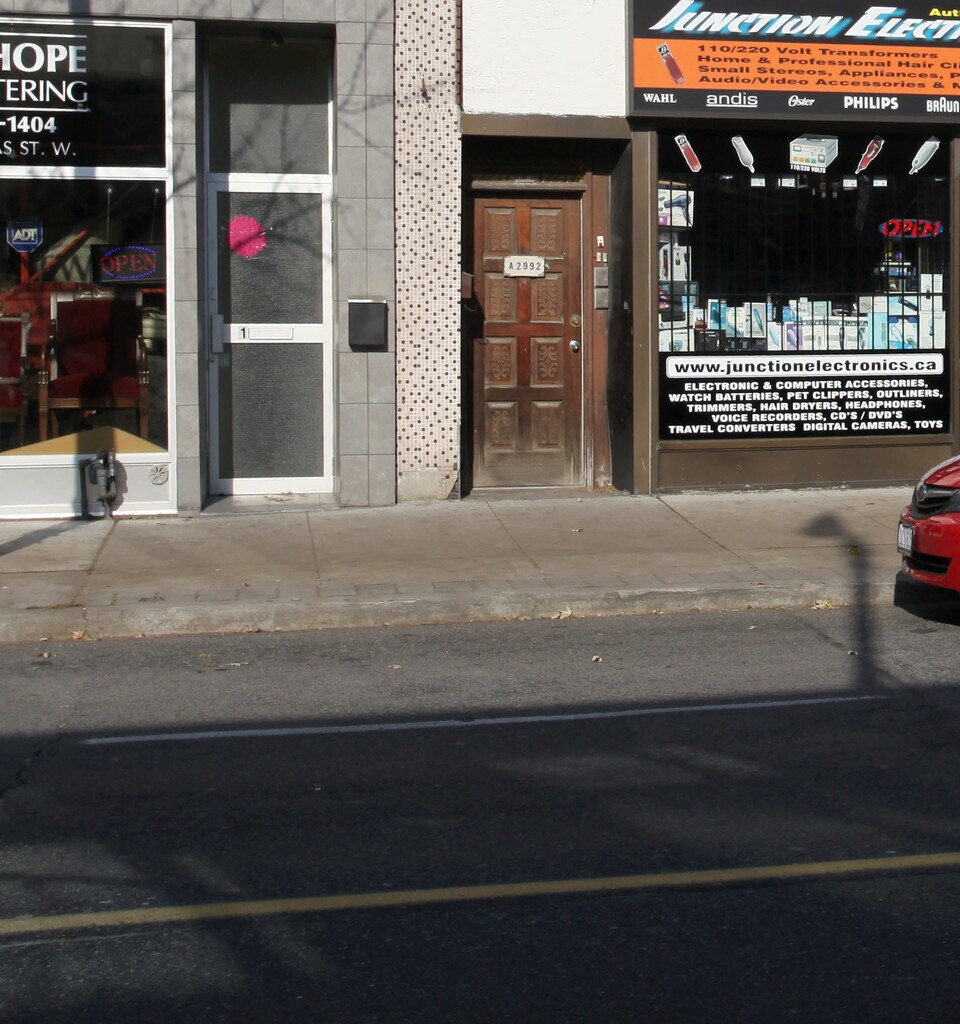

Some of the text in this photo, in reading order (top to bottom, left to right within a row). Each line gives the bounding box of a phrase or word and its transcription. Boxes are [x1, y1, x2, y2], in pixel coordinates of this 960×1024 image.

[648, 0, 844, 35] JUNCTION
[698, 45, 938, 59] 110/220 Volt Transformers
[698, 55, 750, 64] Home
[778, 57, 891, 67] Professional
[898, 61, 934, 69] Hair
[698, 65, 749, 74] Small
[756, 67, 833, 77] Stereos,
[839, 69, 944, 80] Appliances,
[699, 76, 808, 86] Audio/Video
[816, 79, 926, 88] Accessories
[643, 93, 677, 104] WAHL
[706, 93, 758, 106] andis
[788, 95, 815, 107] Oster
[844, 96, 899, 109] PHILIPS
[926, 97, 960, 112] BRAUN
[20, 141, 45, 156] ST.
[52, 141, 77, 156] W.
[790, 164, 826, 174] 110/220 VOLTS
[13, 228, 37, 241] ADT
[883, 219, 942, 237] OPEN
[101, 253, 157, 272] OPEN
[240, 327, 246, 339] 1
[675, 359, 936, 375] www.junctionelectronics.ca
[684, 379, 928, 391] ELECTRONIC & COMPUTER ACCESSORIES,
[668, 389, 943, 402] WATCH BATTERIES, PET CLIPPERS, OUTLINERS,
[687, 400, 926, 413] TRIMMERS, HAIR DRYERS, HEADPHONES,
[711, 410, 903, 423] VOICE RECORDERS, CD'S / DVD'S
[668, 420, 943, 434] TRAVEL CONVERTERS DIGITAL CAMERAS, TOYS
